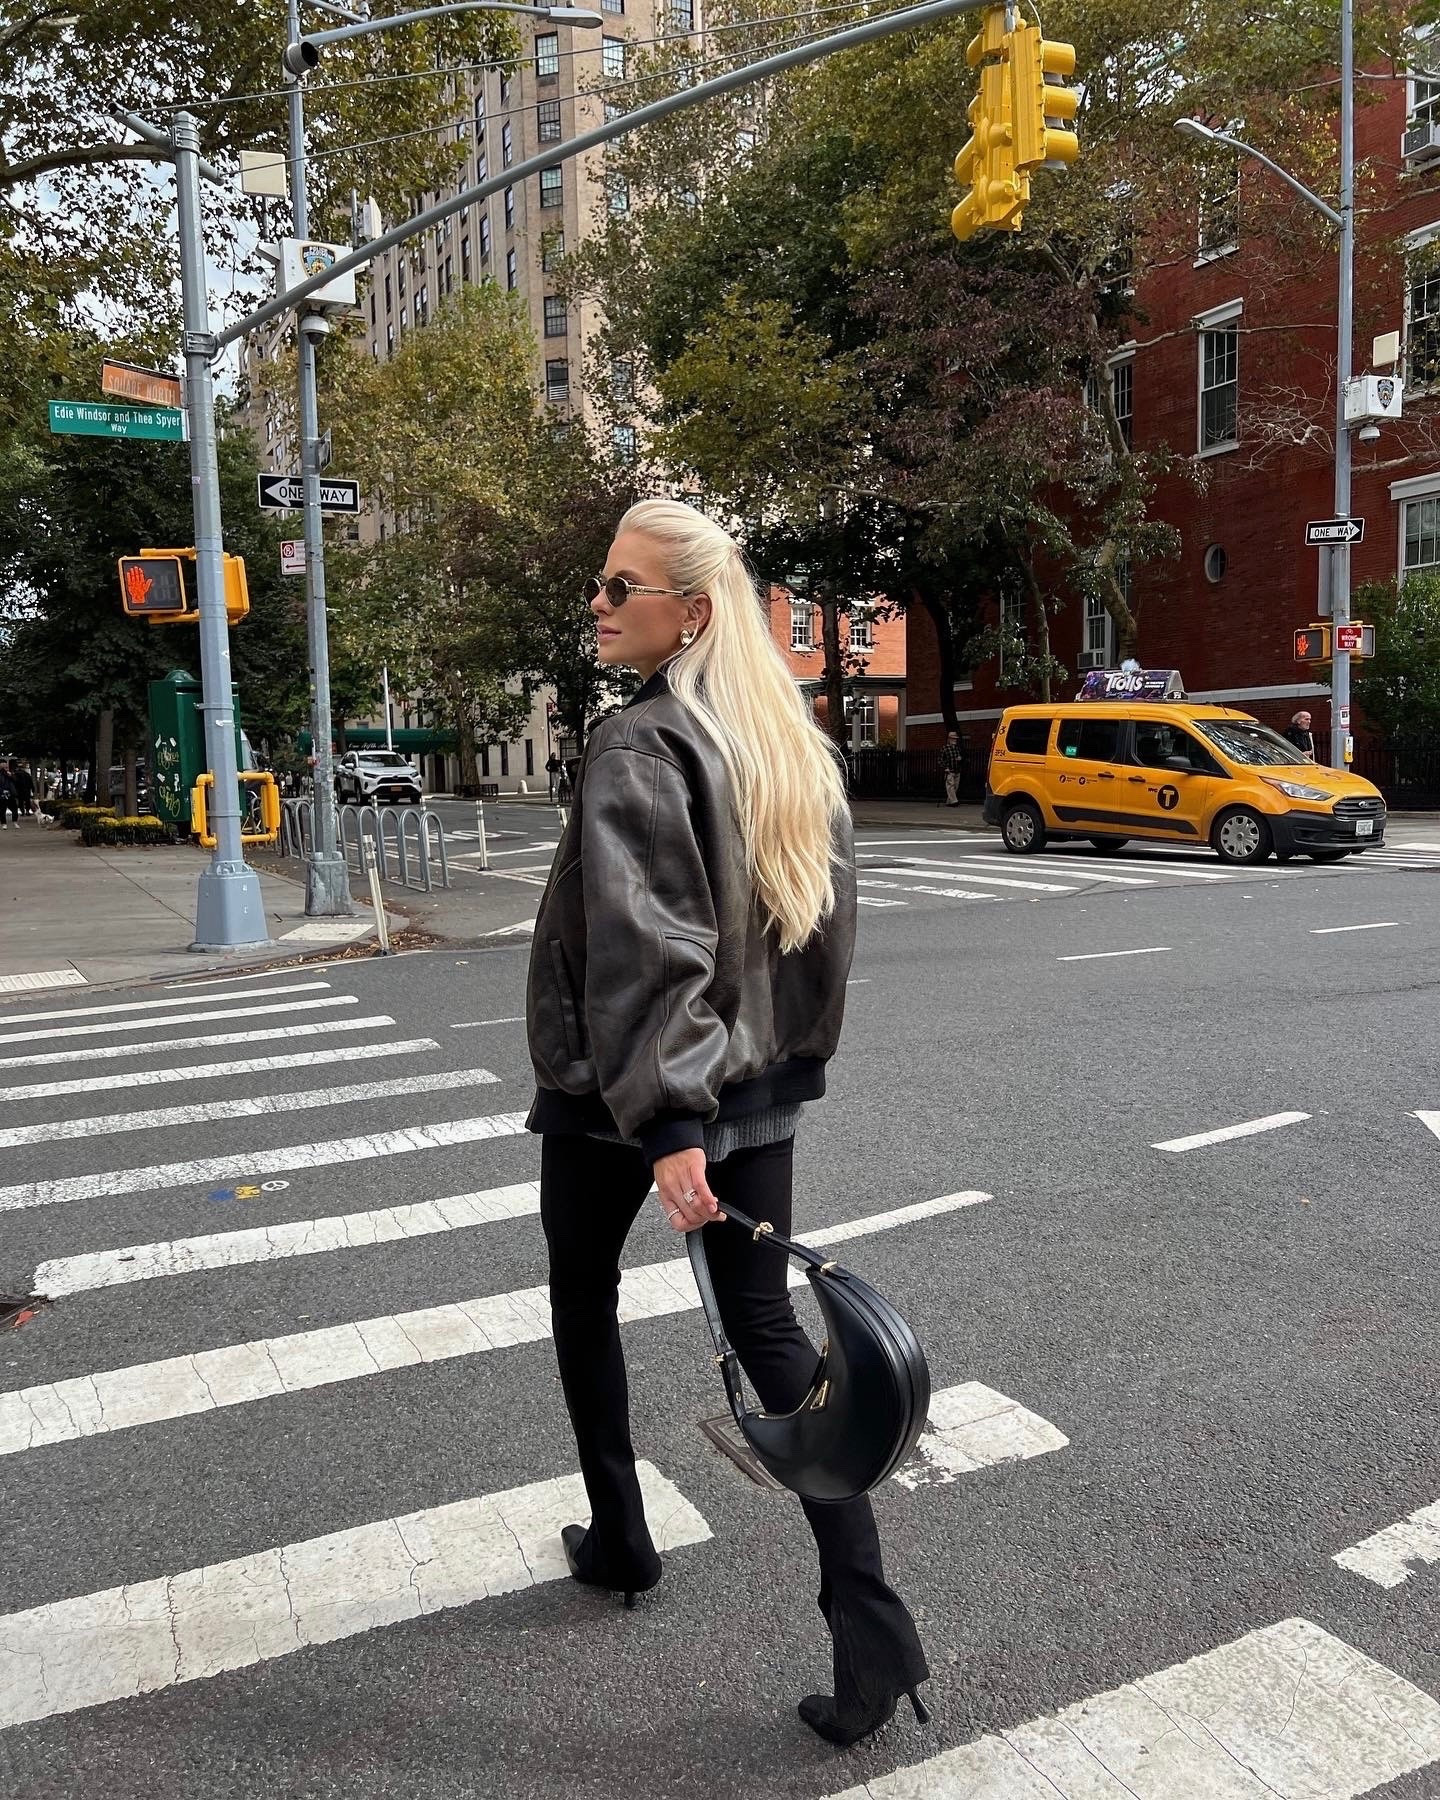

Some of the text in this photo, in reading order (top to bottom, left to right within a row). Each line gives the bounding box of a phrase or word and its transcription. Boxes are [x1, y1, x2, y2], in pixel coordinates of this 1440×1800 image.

[54, 406, 180, 427] Edie Windsor and Thea Spyer
[111, 423, 127, 434] Way
[280, 486, 347, 502] ONE WAY
[1314, 526, 1355, 537] ONE WAY
[1162, 789, 1175, 807] T
